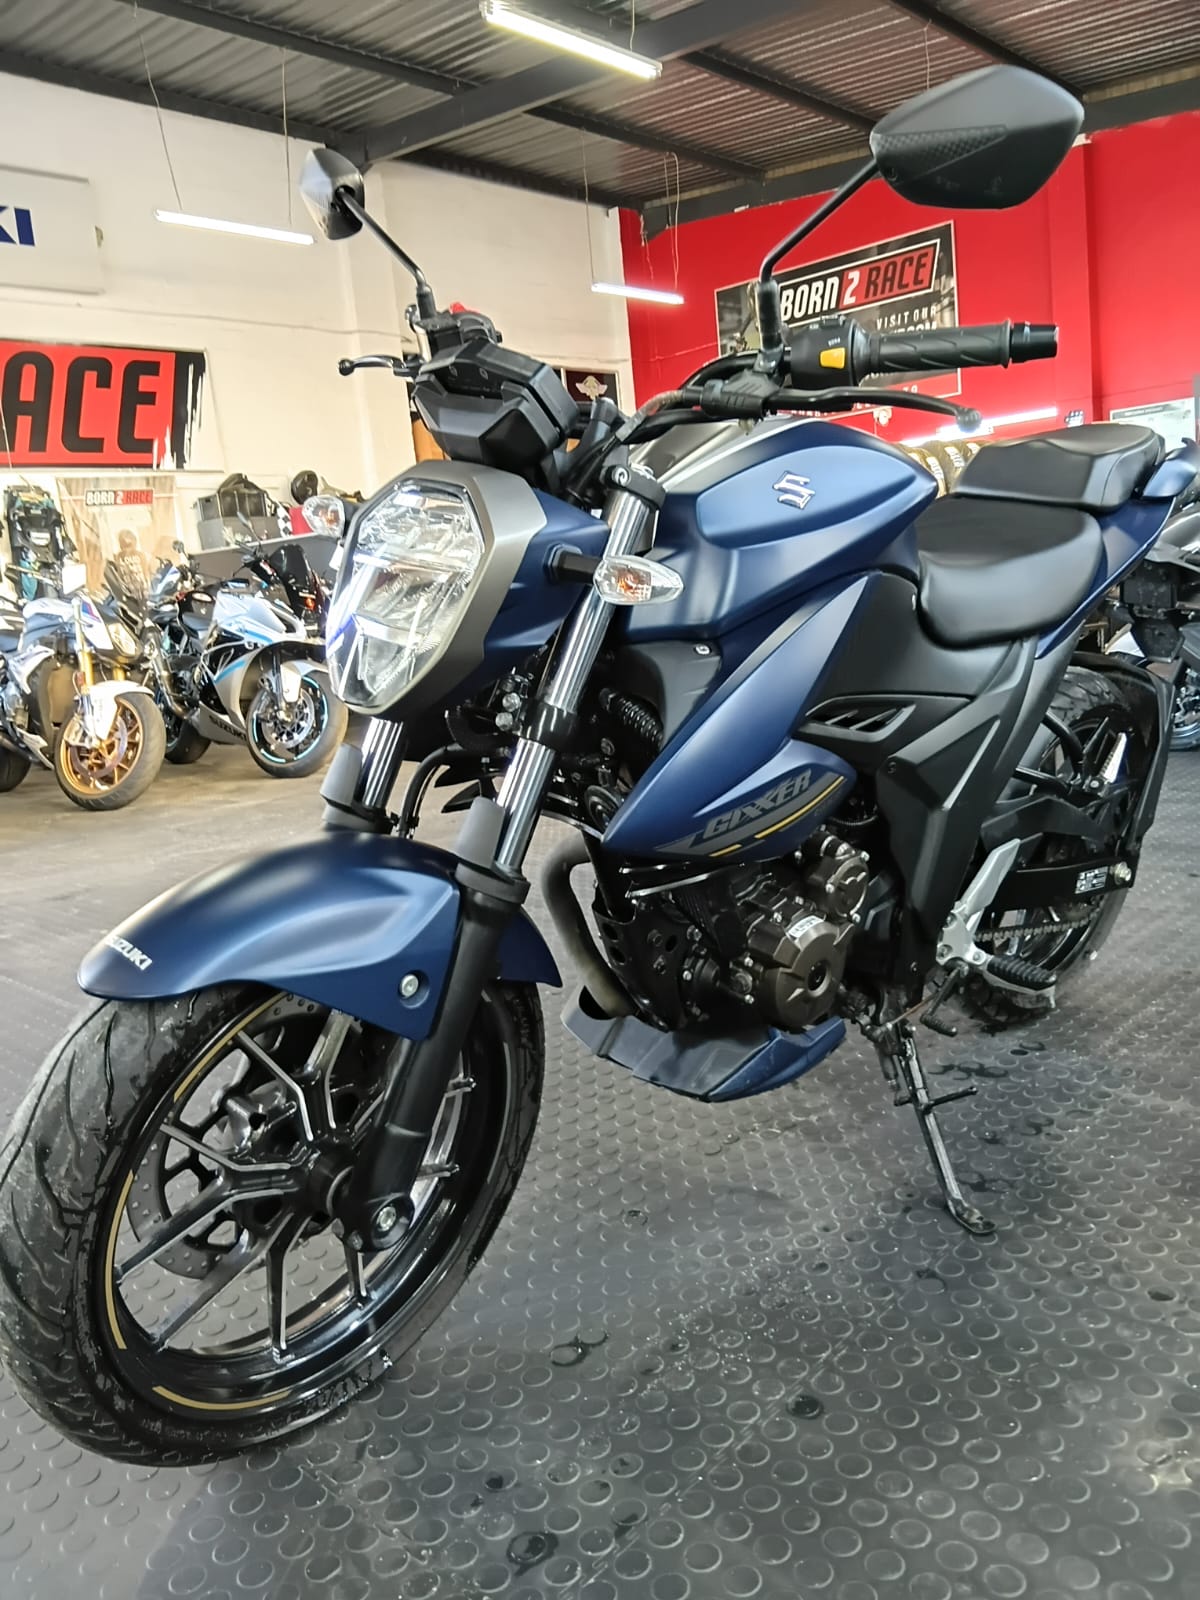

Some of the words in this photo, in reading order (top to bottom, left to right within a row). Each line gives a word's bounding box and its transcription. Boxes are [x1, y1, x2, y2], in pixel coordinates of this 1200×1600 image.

[780, 276, 840, 322] BORN
[842, 270, 861, 305] 2
[864, 251, 930, 299] RACE
[876, 311, 910, 331] VISIT
[913, 305, 937, 322] OUR
[0, 351, 160, 453] ACE
[86, 490, 115, 505] BORN
[115, 490, 125, 505] 2
[702, 768, 812, 840] GIXXER
